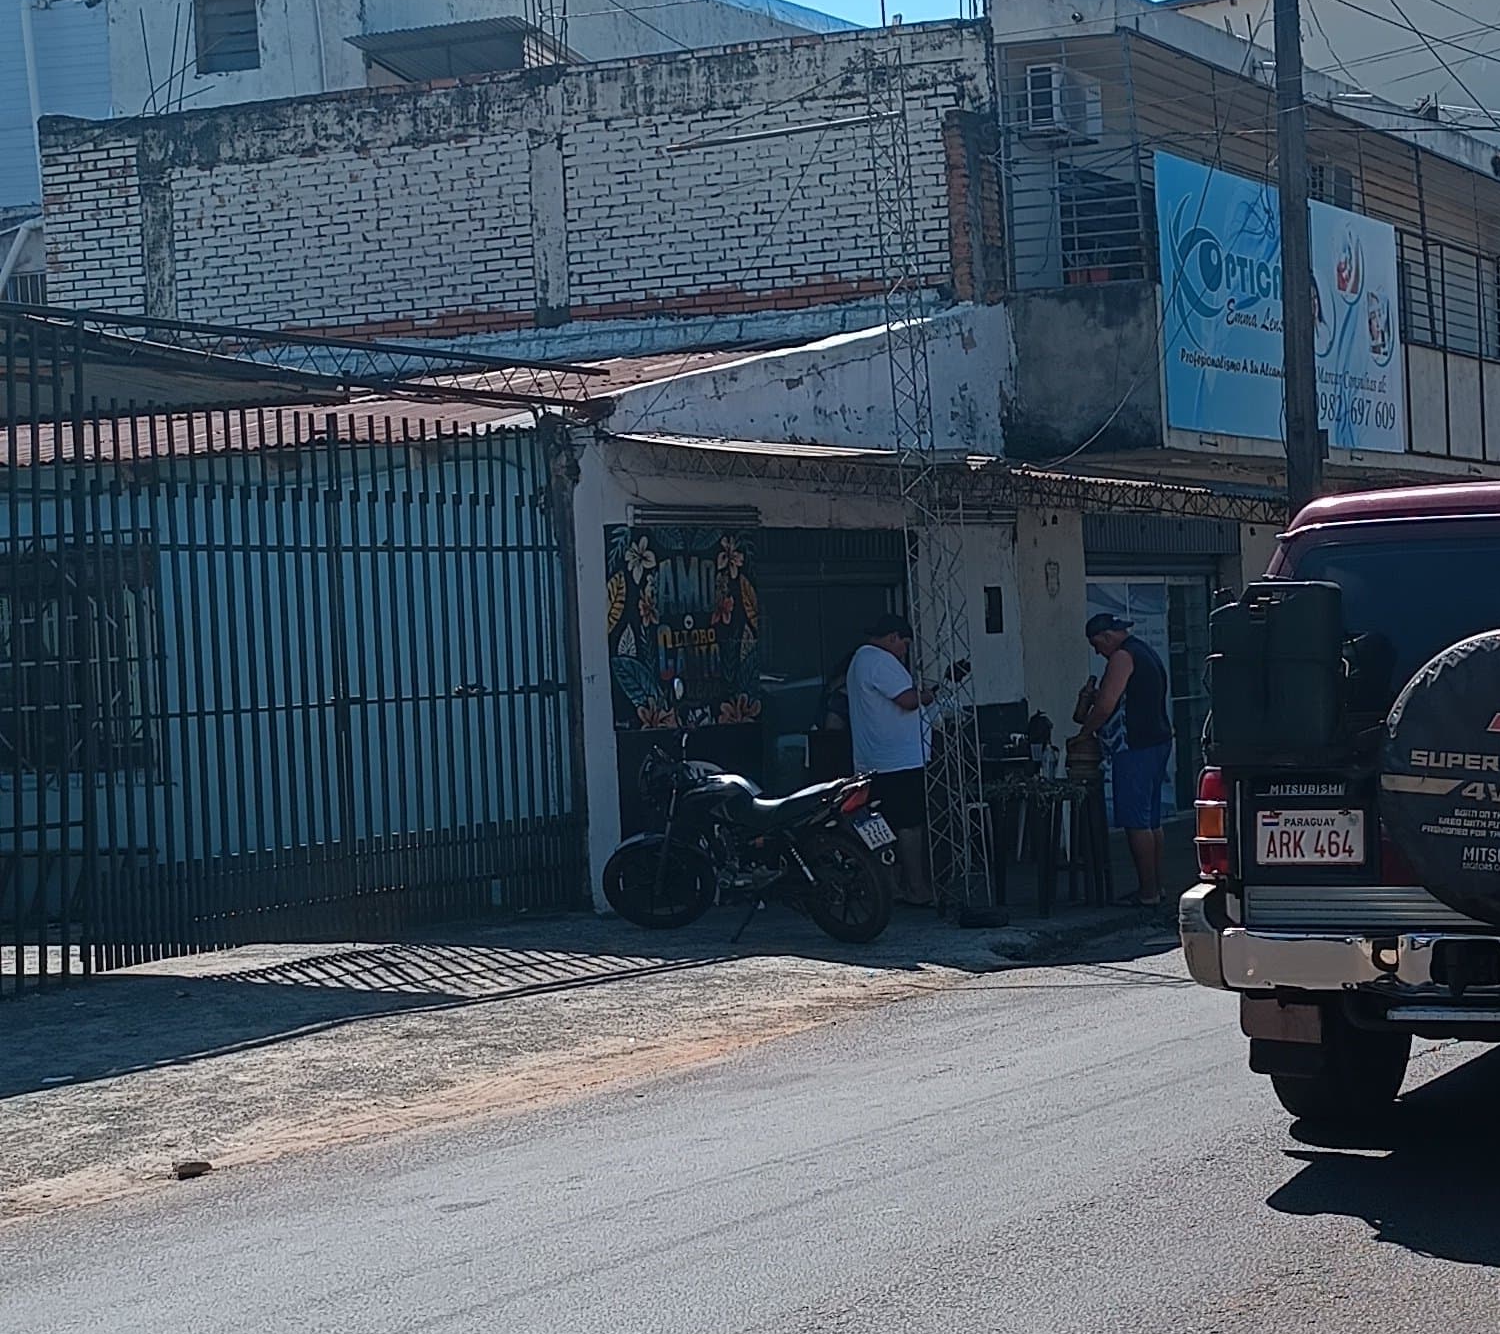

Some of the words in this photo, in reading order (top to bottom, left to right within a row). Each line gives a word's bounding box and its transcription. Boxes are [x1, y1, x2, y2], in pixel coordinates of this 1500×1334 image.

[1226, 298, 1257, 328] Emma
[1260, 363, 1285, 378] Alcan
[1351, 397, 1372, 426] 697
[1375, 401, 1396, 430] 609
[1410, 749, 1499, 772] SUPER
[1269, 784, 1344, 796] MITSUBISHI
[1284, 818, 1336, 827] PARAGUAY
[1470, 828, 1486, 838] FOR
[1267, 830, 1305, 858] ARK
[1314, 830, 1354, 858] 464
[1462, 862, 1493, 872] MOTORS
